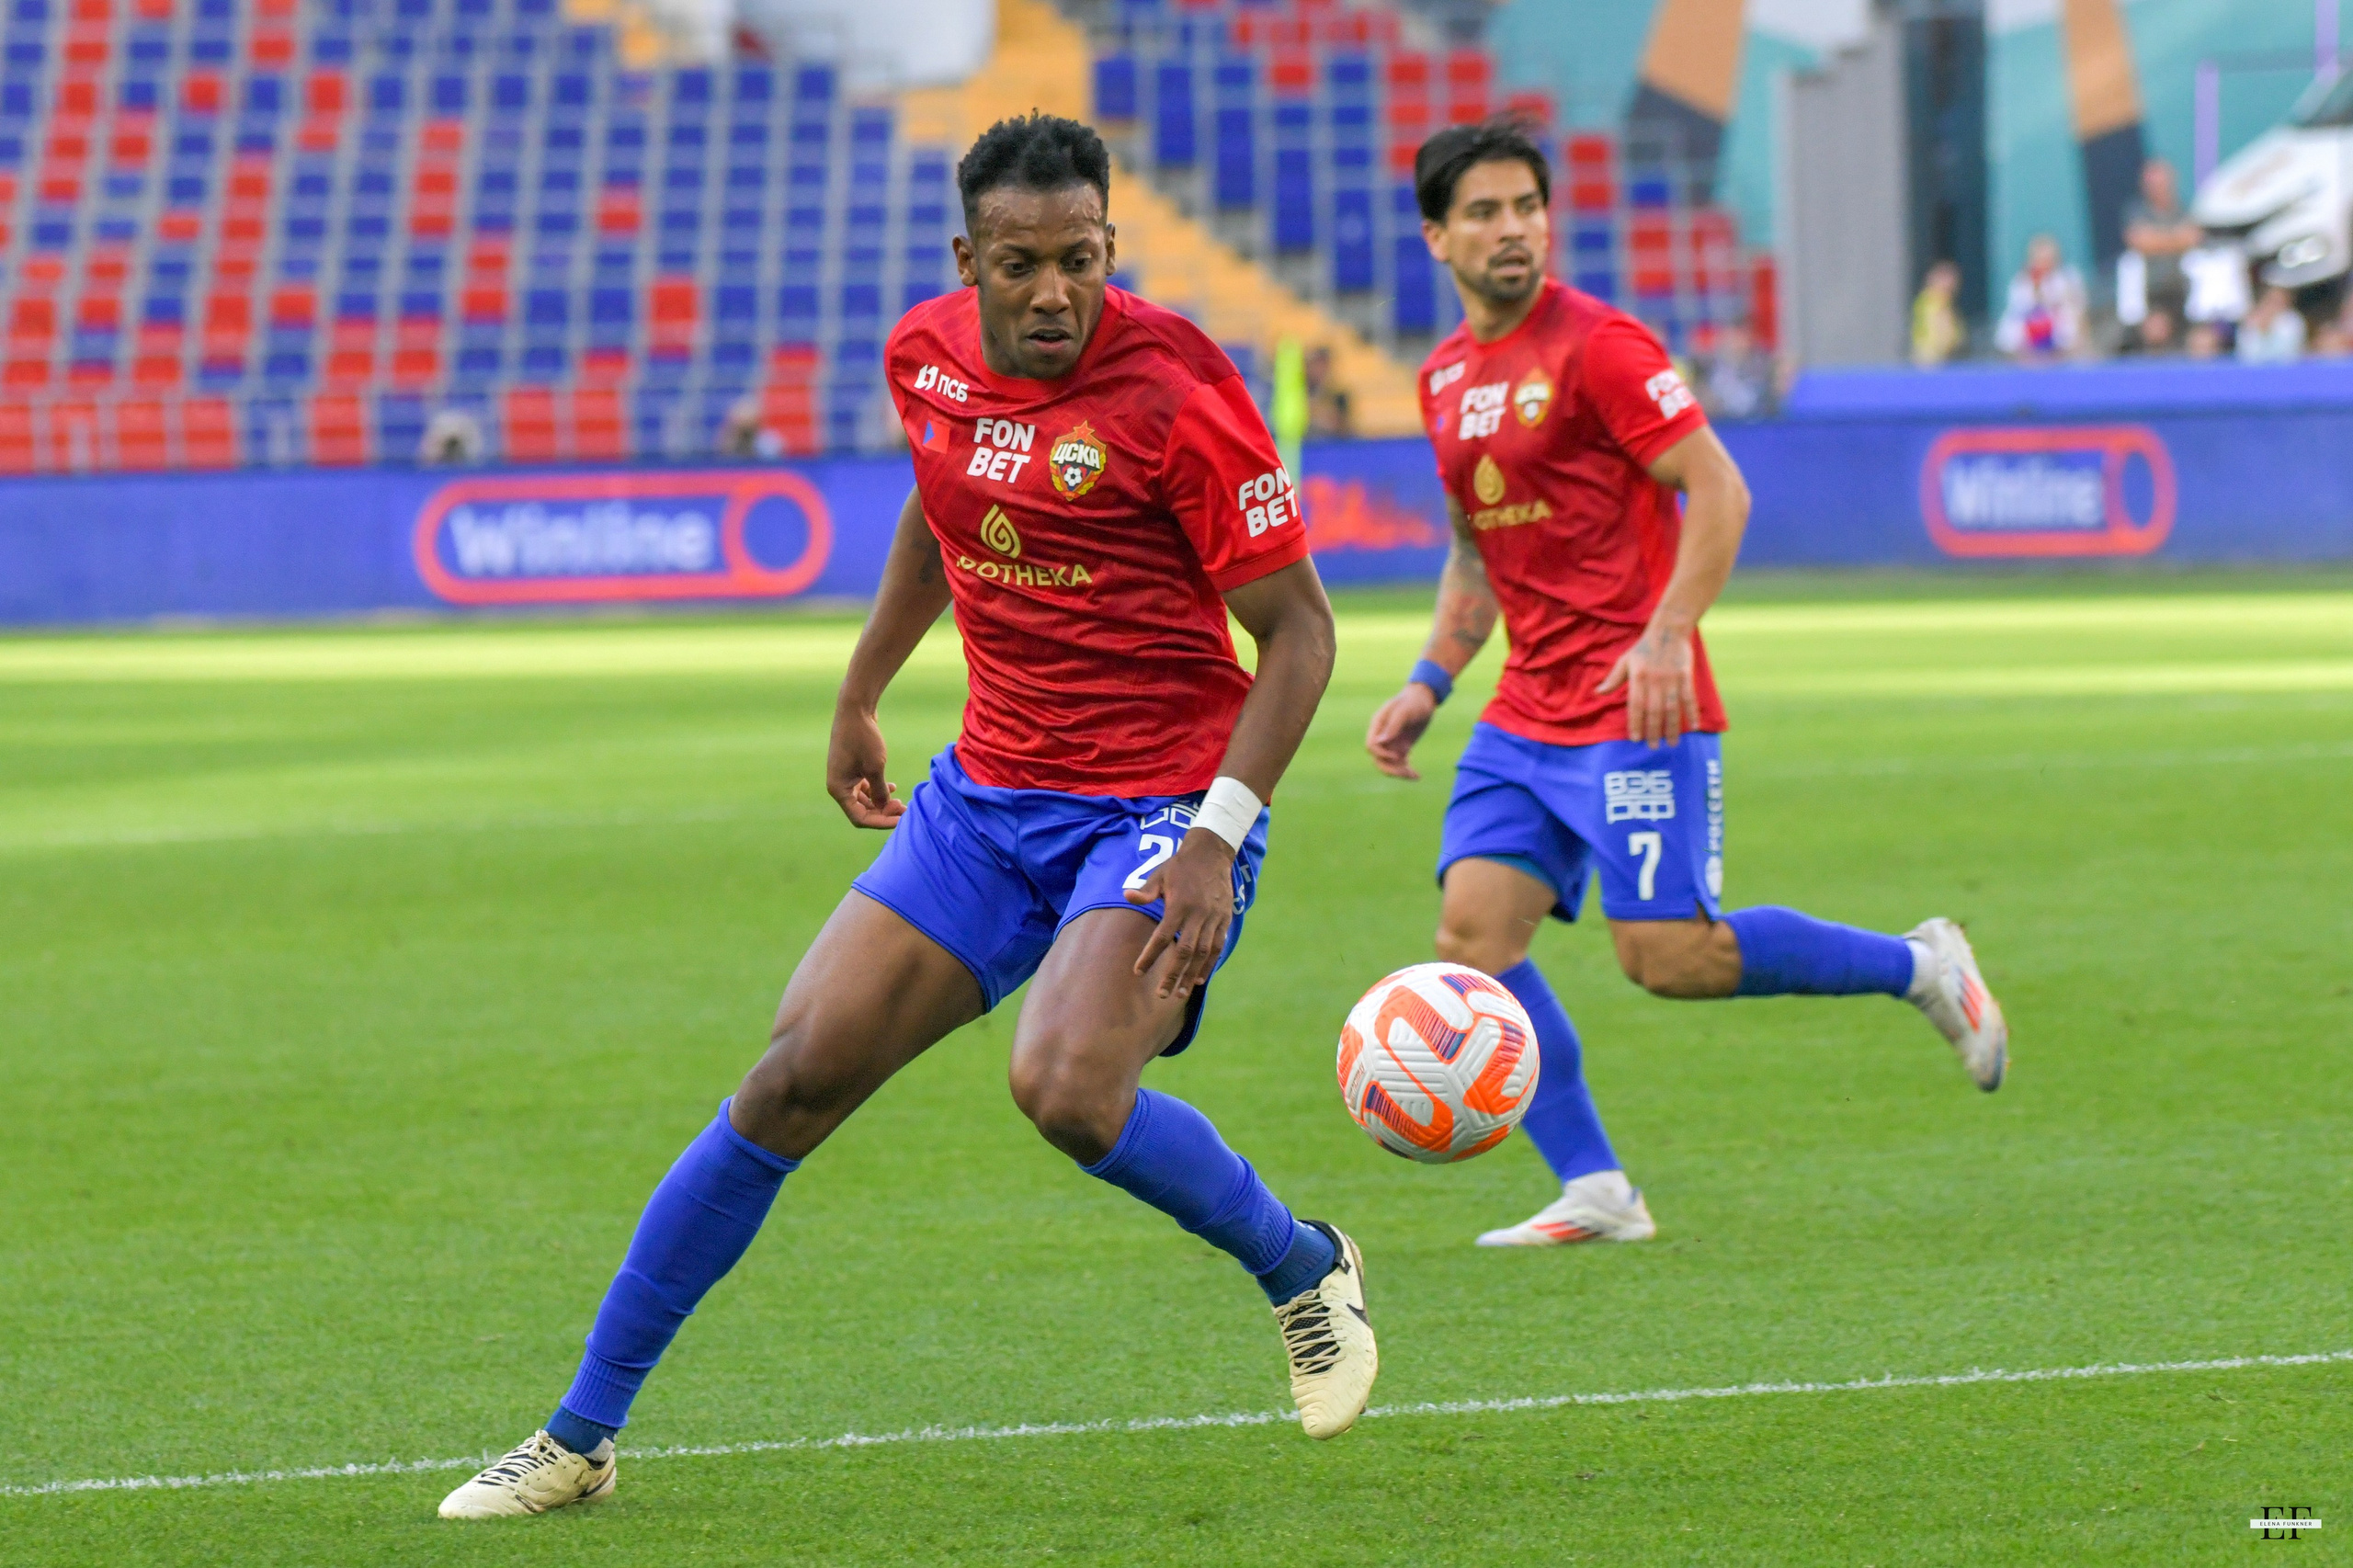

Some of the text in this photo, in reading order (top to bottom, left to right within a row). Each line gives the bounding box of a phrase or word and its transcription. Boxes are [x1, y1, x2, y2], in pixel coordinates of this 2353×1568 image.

[937, 374, 969, 403] ПСБ
[973, 417, 1036, 452] FON
[1053, 443, 1101, 470] ЦСКА
[966, 447, 1031, 483] BET
[1238, 467, 1291, 511] FON
[1245, 487, 1298, 538] BET
[449, 501, 713, 575] Winline
[1122, 834, 1184, 889] 2
[1628, 831, 1662, 901] 7
